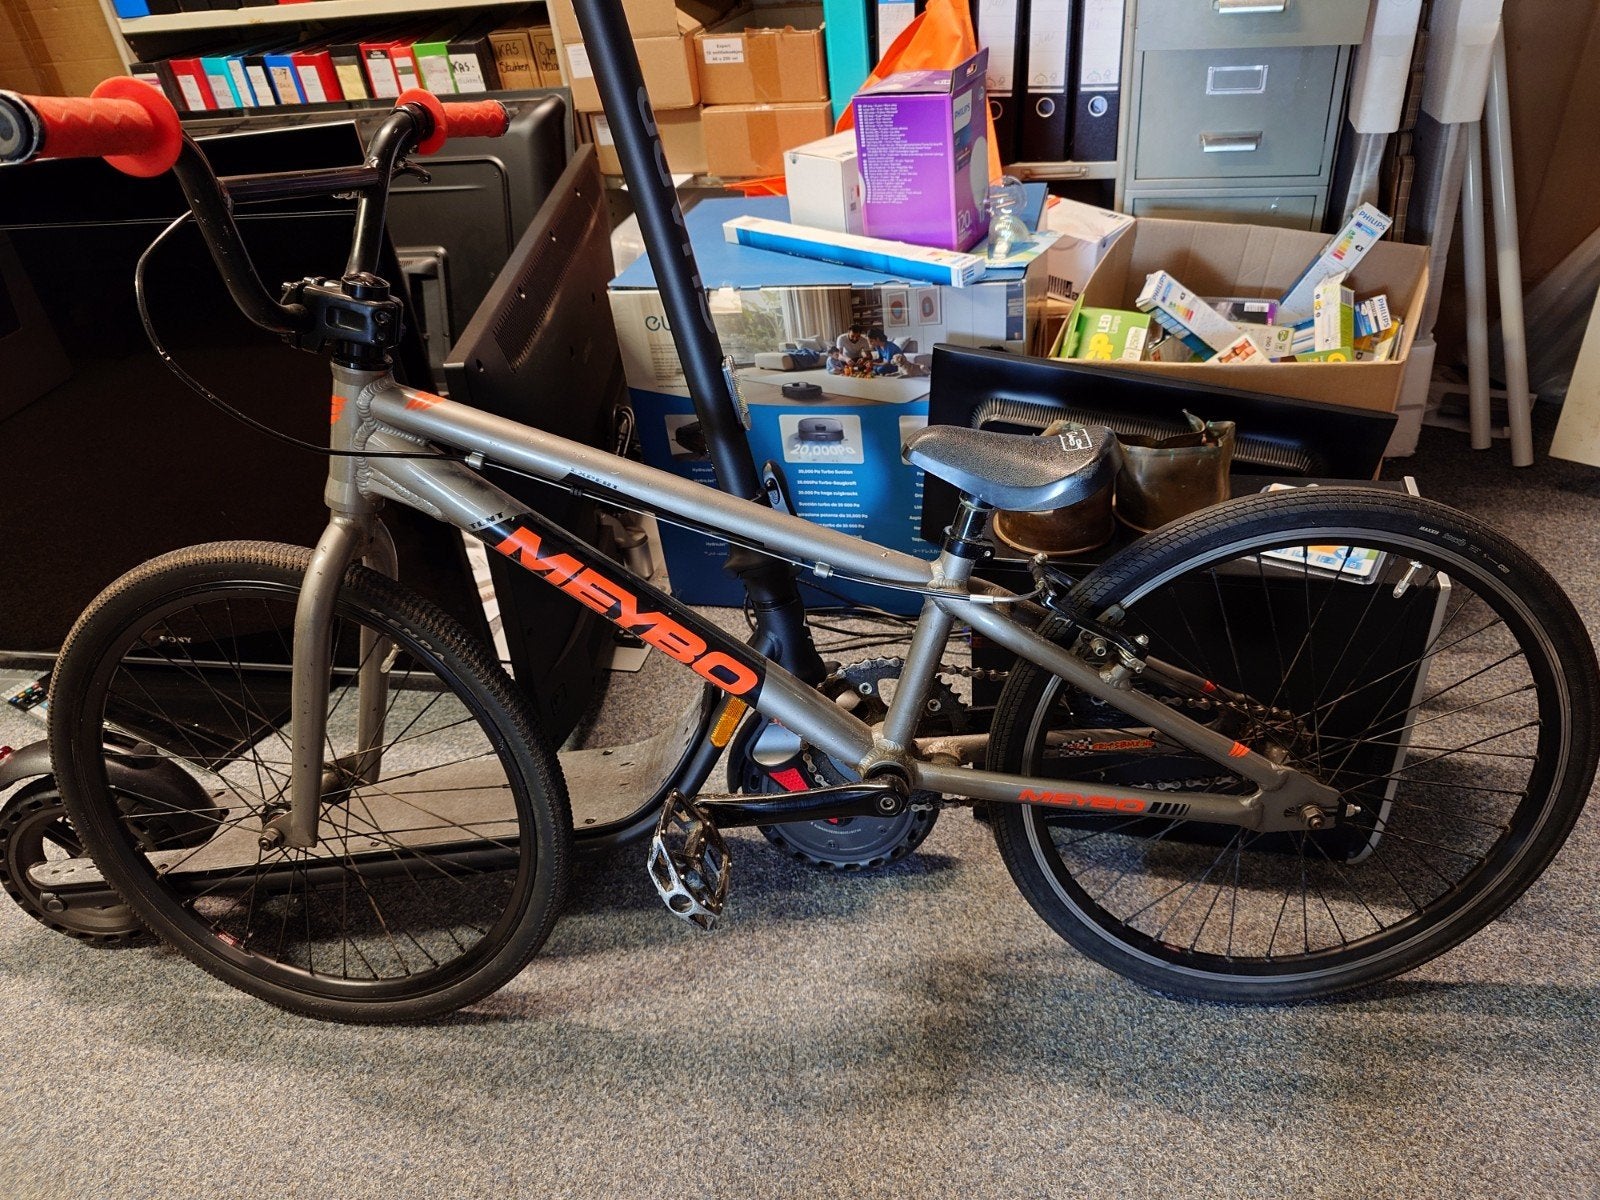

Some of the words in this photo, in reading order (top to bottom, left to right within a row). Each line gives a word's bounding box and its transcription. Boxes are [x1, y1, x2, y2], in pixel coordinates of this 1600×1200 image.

[953, 102, 971, 119] PHILIPS
[1359, 210, 1387, 231] PHILIPS
[1151, 274, 1167, 301] PHILIPS
[645, 315, 671, 331] eu
[1377, 297, 1391, 329] PHILIPS
[790, 443, 856, 457] 20,000Pa
[496, 526, 758, 695] MEYBO
[159, 635, 192, 643] SONY
[1017, 788, 1146, 813] MEYBO
